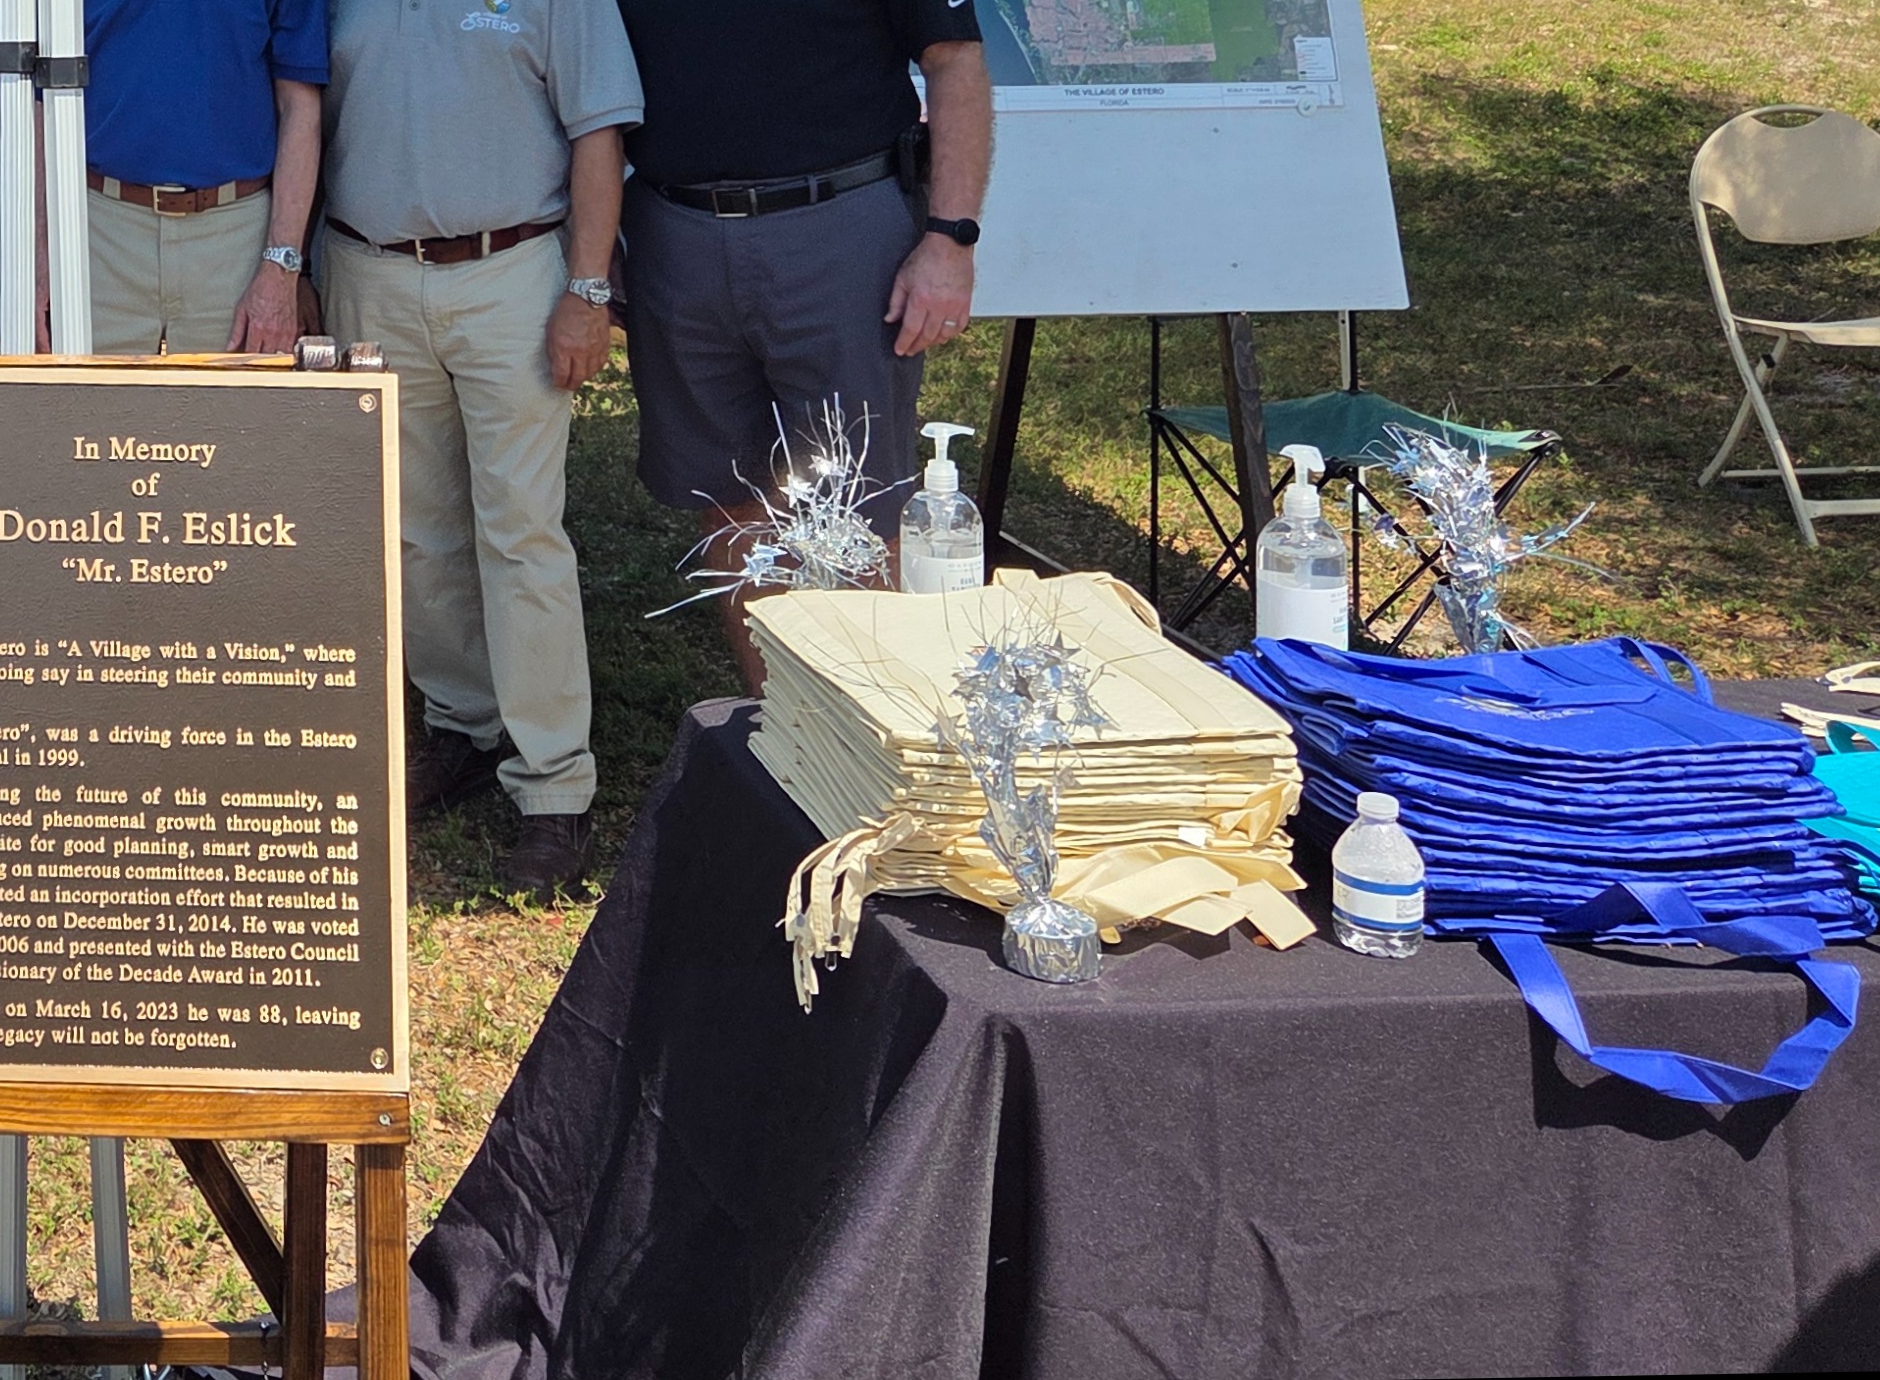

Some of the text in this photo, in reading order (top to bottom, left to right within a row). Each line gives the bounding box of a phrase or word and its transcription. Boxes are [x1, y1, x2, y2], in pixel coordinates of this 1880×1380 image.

[73, 435, 217, 468] In Memory
[131, 471, 161, 496] of
[136, 510, 170, 545] F.
[181, 511, 298, 547] Eslick
[62, 557, 229, 584] “Mr. Estero”
[34, 638, 50, 657] is
[89, 639, 152, 662] Village
[158, 640, 199, 660] with
[206, 644, 217, 660] a
[302, 643, 357, 663] where
[41, 666, 71, 687] say
[75, 662, 95, 682] in
[99, 664, 169, 688] steering
[175, 665, 217, 685] their
[221, 667, 318, 691] community
[323, 667, 357, 688] and
[45, 726, 79, 743] was
[88, 727, 100, 743] a
[108, 724, 172, 750] driving
[180, 724, 227, 746] force
[235, 726, 255, 747] in
[263, 727, 292, 747] the
[300, 728, 358, 750] Estero
[5, 1002, 28, 1018] on
[35, 997, 92, 1019] March
[101, 999, 128, 1023] 16,
[135, 1000, 179, 1021] 2023
[187, 1002, 209, 1023] he
[216, 1006, 251, 1024] was
[259, 1003, 288, 1027] 88,
[295, 1004, 361, 1031] leaving
[51, 1024, 86, 1045] will
[90, 1028, 120, 1046] not
[124, 1026, 145, 1047] be
[150, 1026, 237, 1052] forgotten.
